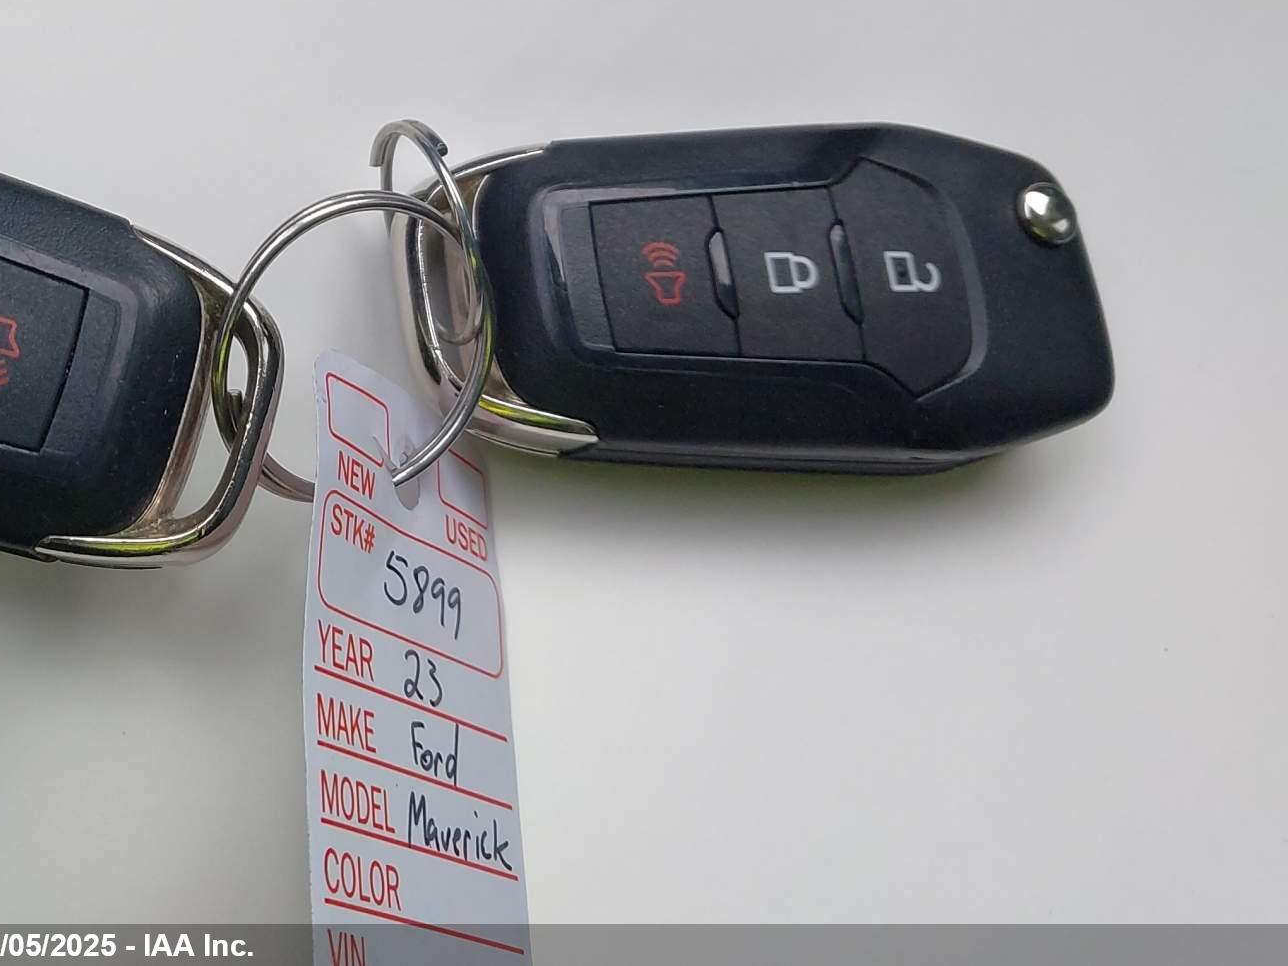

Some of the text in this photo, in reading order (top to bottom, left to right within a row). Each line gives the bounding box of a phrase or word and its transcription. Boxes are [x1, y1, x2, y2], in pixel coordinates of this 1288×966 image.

[337, 450, 375, 500] NEW
[330, 503, 375, 554] STK#
[445, 514, 488, 562] USED
[384, 550, 462, 640] 5899
[318, 619, 374, 682] YEAR
[404, 649, 443, 707] 23
[317, 693, 376, 753] MAKE
[411, 721, 459, 786] Ford
[320, 769, 395, 834] MODEL
[408, 790, 513, 871] Maverick
[324, 847, 401, 911] COLOR
[327, 929, 367, 966] VIN
